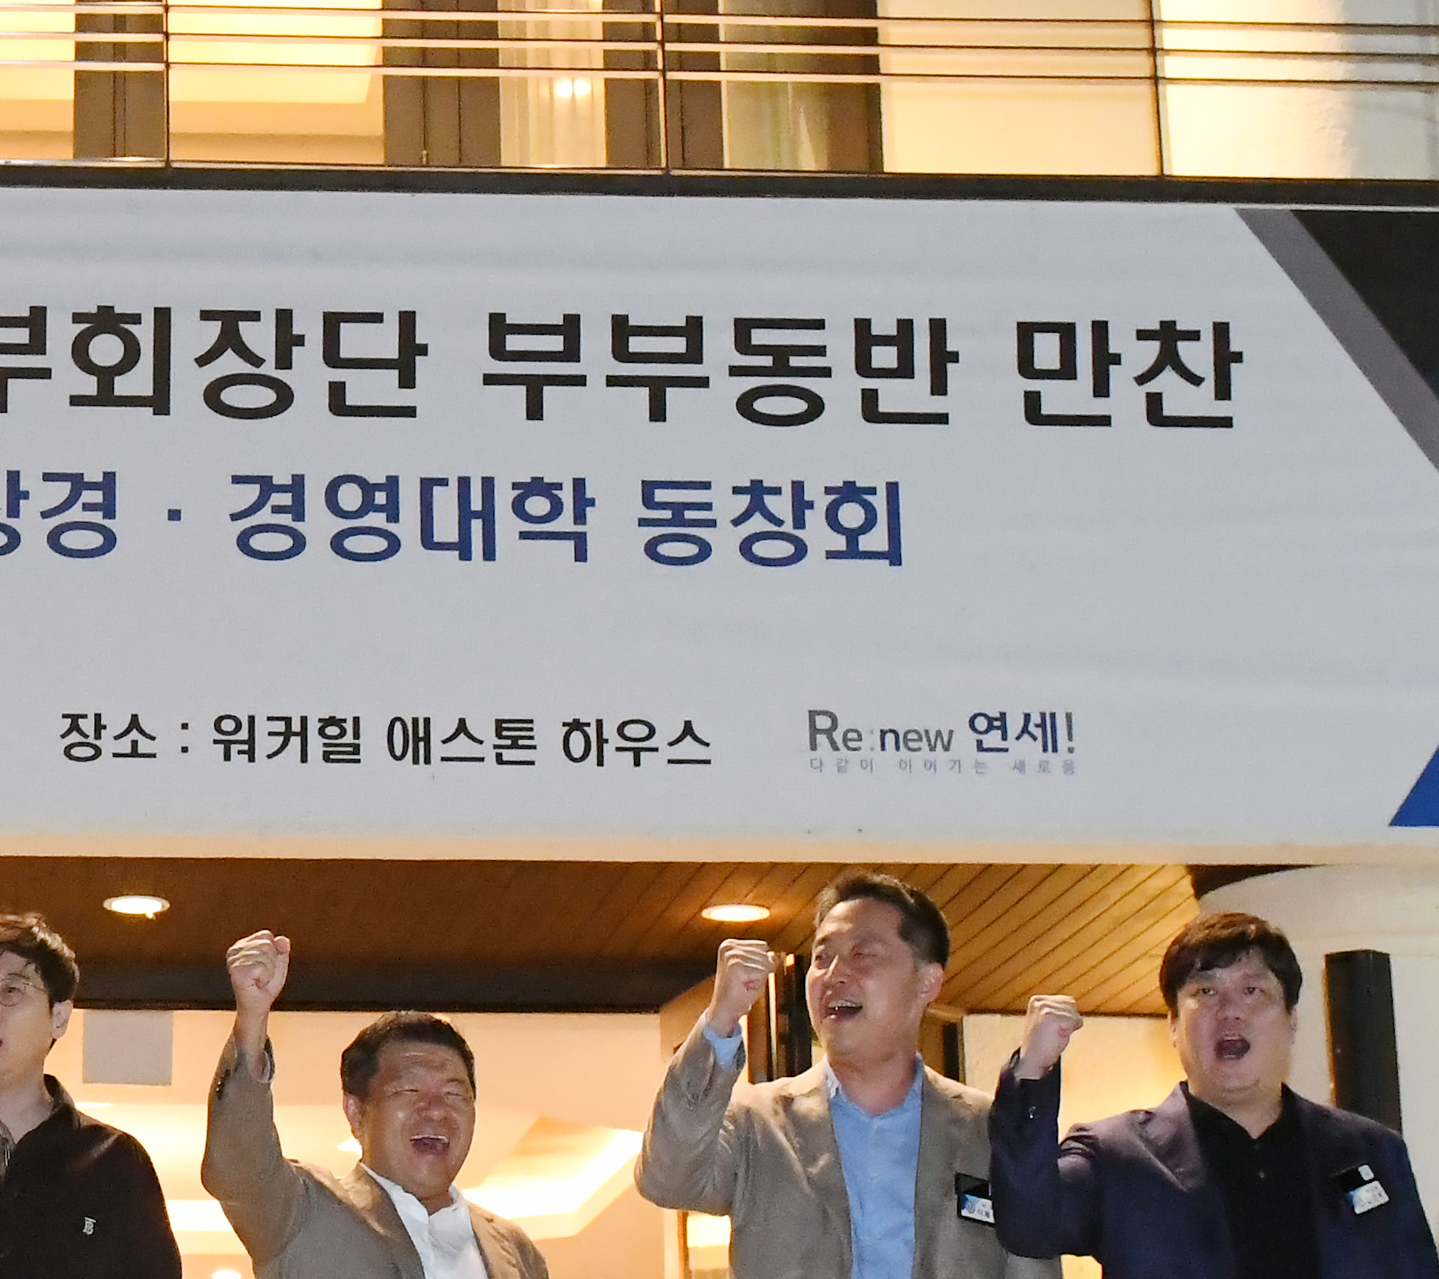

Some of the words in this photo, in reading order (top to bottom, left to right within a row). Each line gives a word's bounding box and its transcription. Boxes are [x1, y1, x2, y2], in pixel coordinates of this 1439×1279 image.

[482, 312, 960, 428] 부부동반
[1016, 319, 1244, 429] 만찬
[228, 473, 596, 564] 경영대학
[637, 479, 903, 568] 동창회
[59, 712, 157, 763] 장소
[212, 714, 362, 764] 워커힐
[386, 716, 538, 766] 애스톤
[561, 718, 712, 768] 하우스
[968, 711, 1075, 754] 연세!
